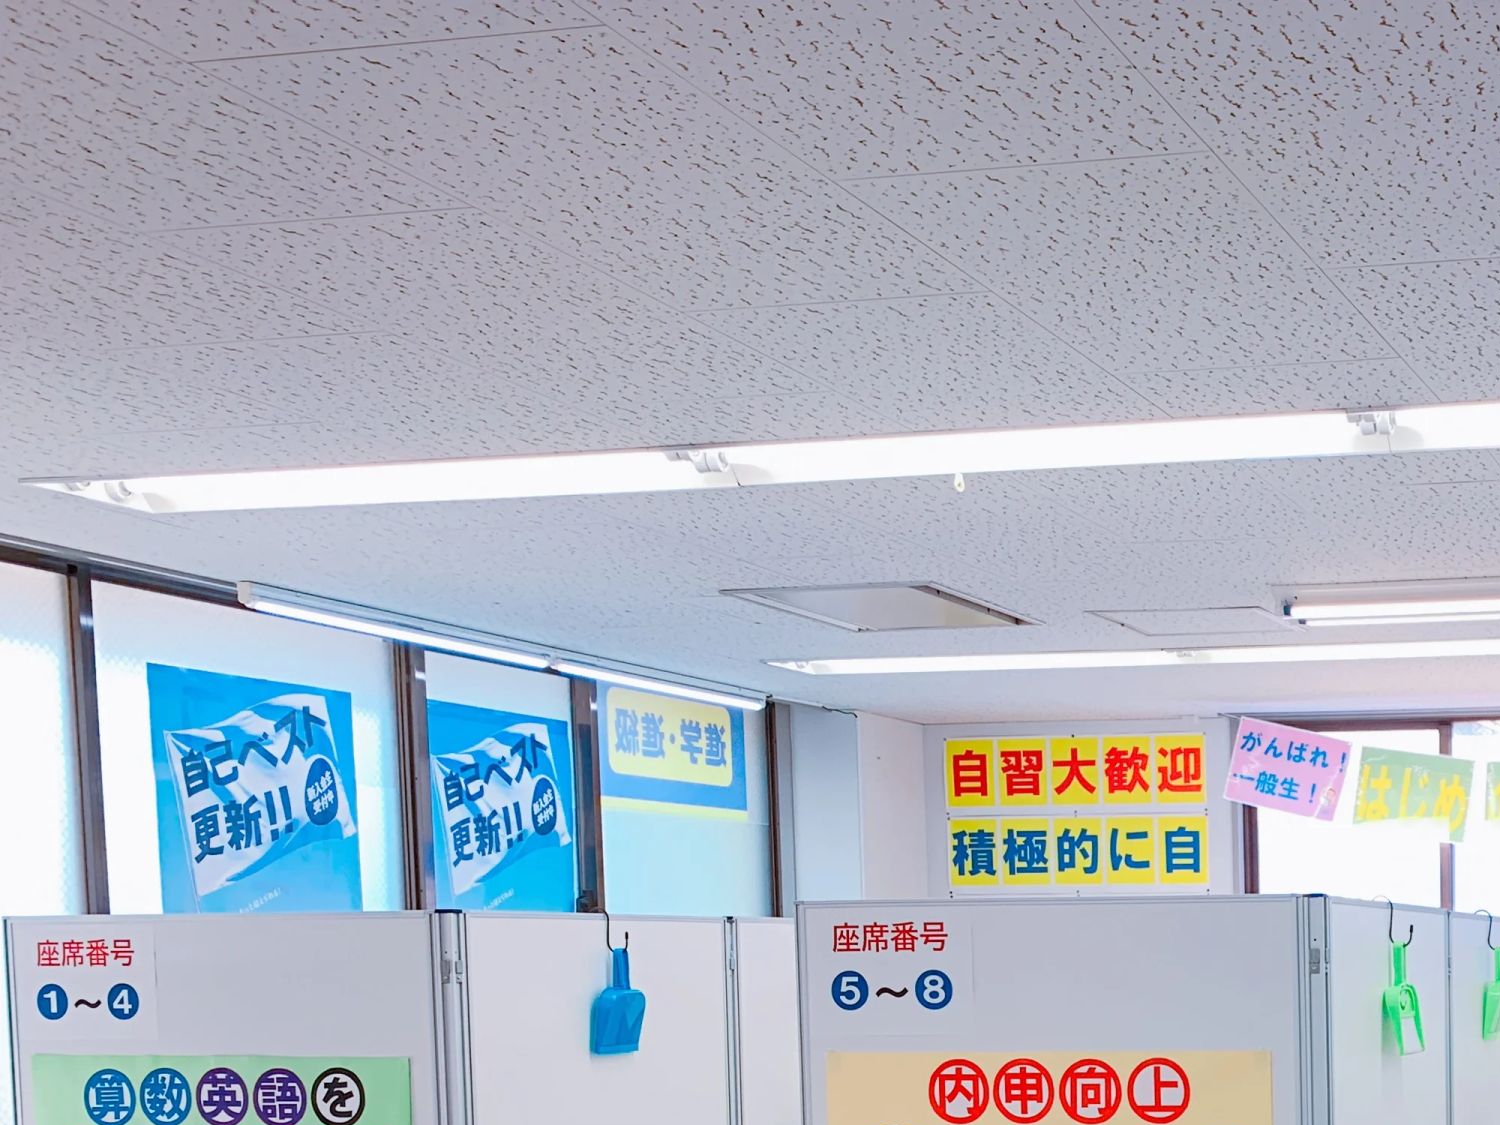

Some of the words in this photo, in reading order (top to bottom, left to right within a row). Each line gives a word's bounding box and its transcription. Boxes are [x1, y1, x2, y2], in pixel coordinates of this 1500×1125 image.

[181, 706, 326, 798] 自己ベスト
[444, 733, 548, 811] 自己ベスト
[952, 746, 1204, 797] 自習大歓迎
[952, 825, 1201, 877] 積極的に自
[36, 939, 134, 967] 座席番号
[832, 922, 948, 953] 座席番号
[929, 1057, 1191, 1125] 内申向上
